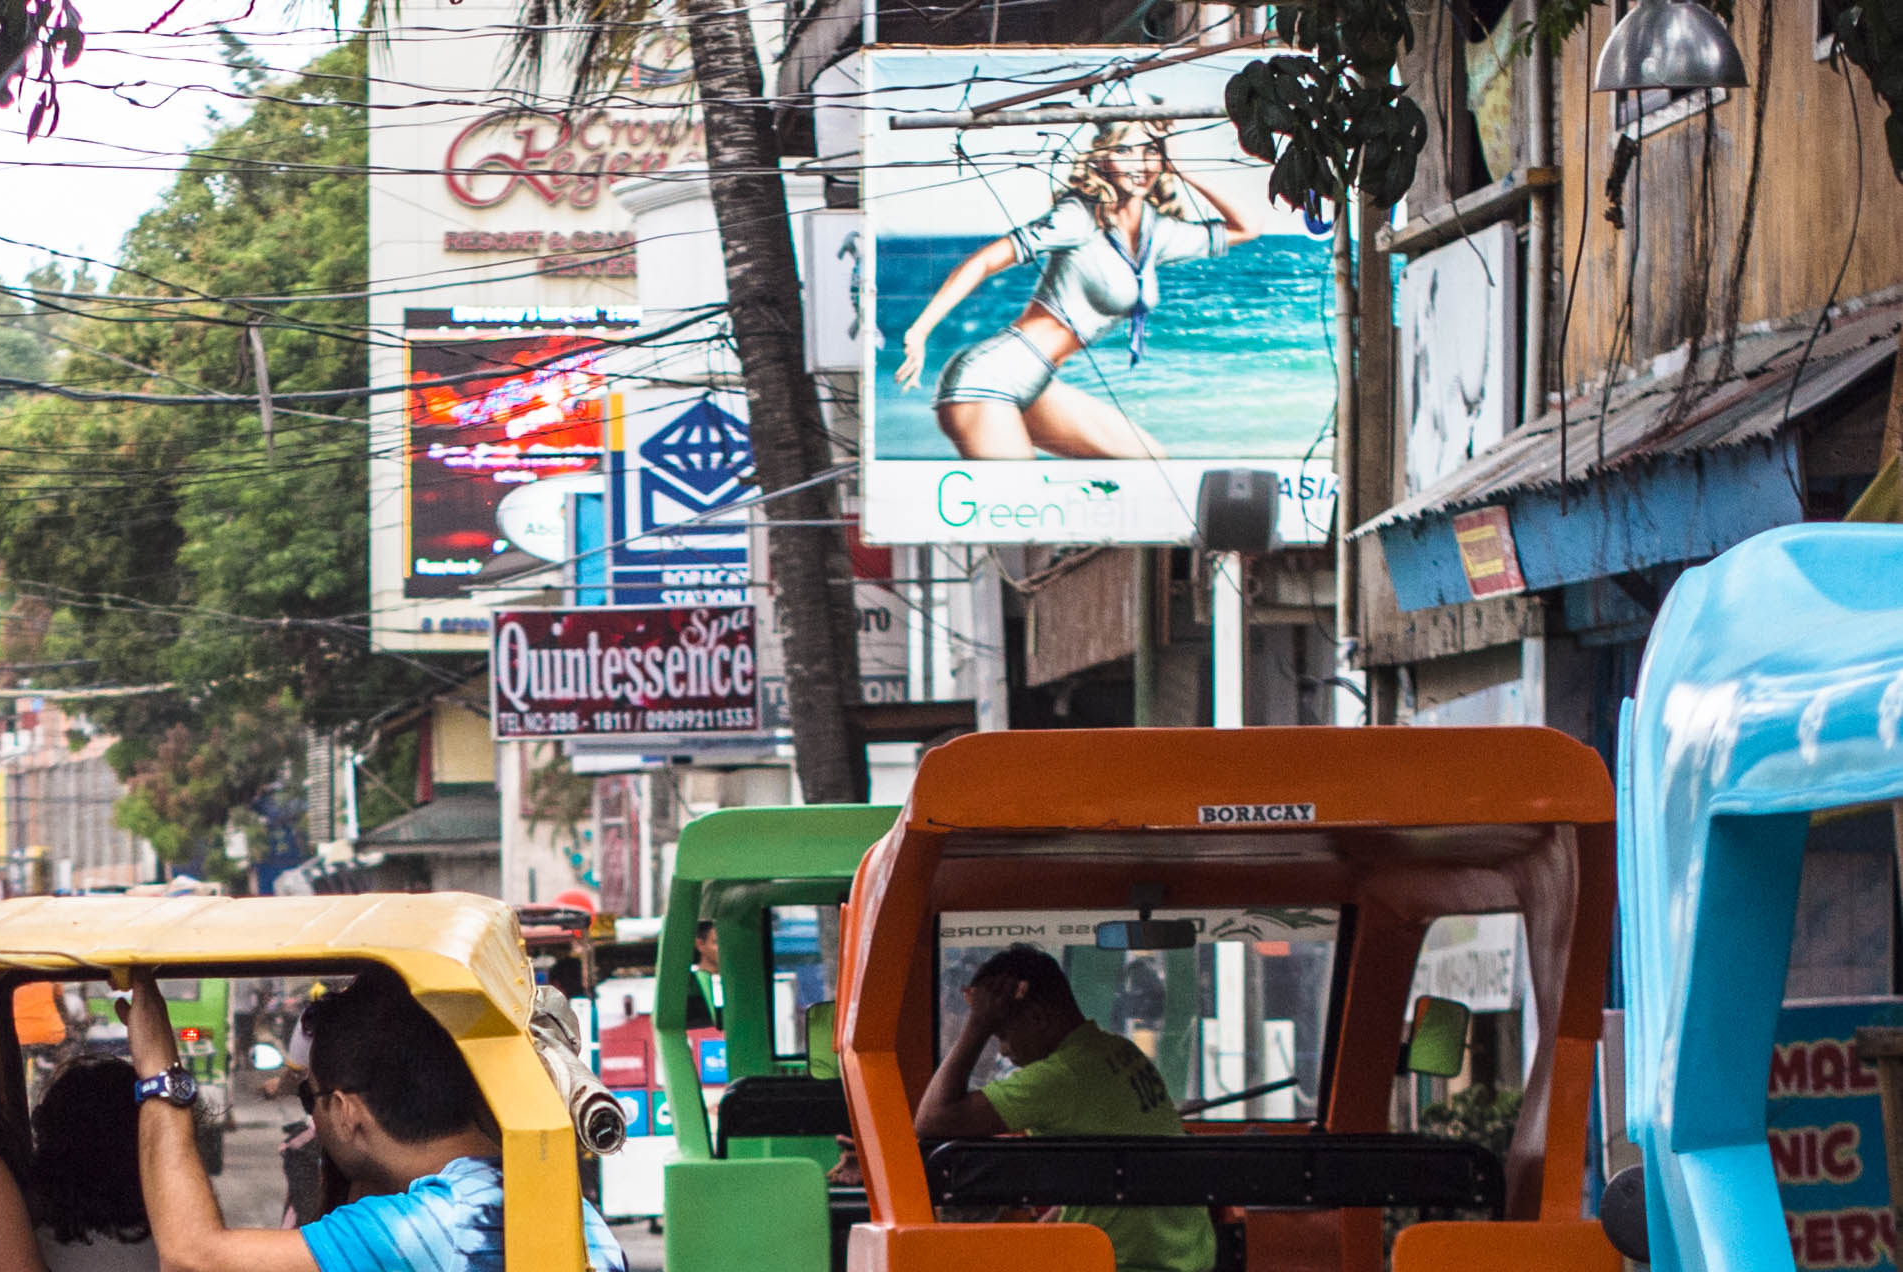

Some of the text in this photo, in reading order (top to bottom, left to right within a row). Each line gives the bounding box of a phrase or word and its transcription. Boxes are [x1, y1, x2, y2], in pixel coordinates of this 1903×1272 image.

[443, 231, 543, 251] RESORT
[538, 256, 637, 277] CENTER
[679, 606, 750, 650] Spa
[497, 620, 754, 712] Quintessence
[1201, 804, 1313, 822] BORACAY
